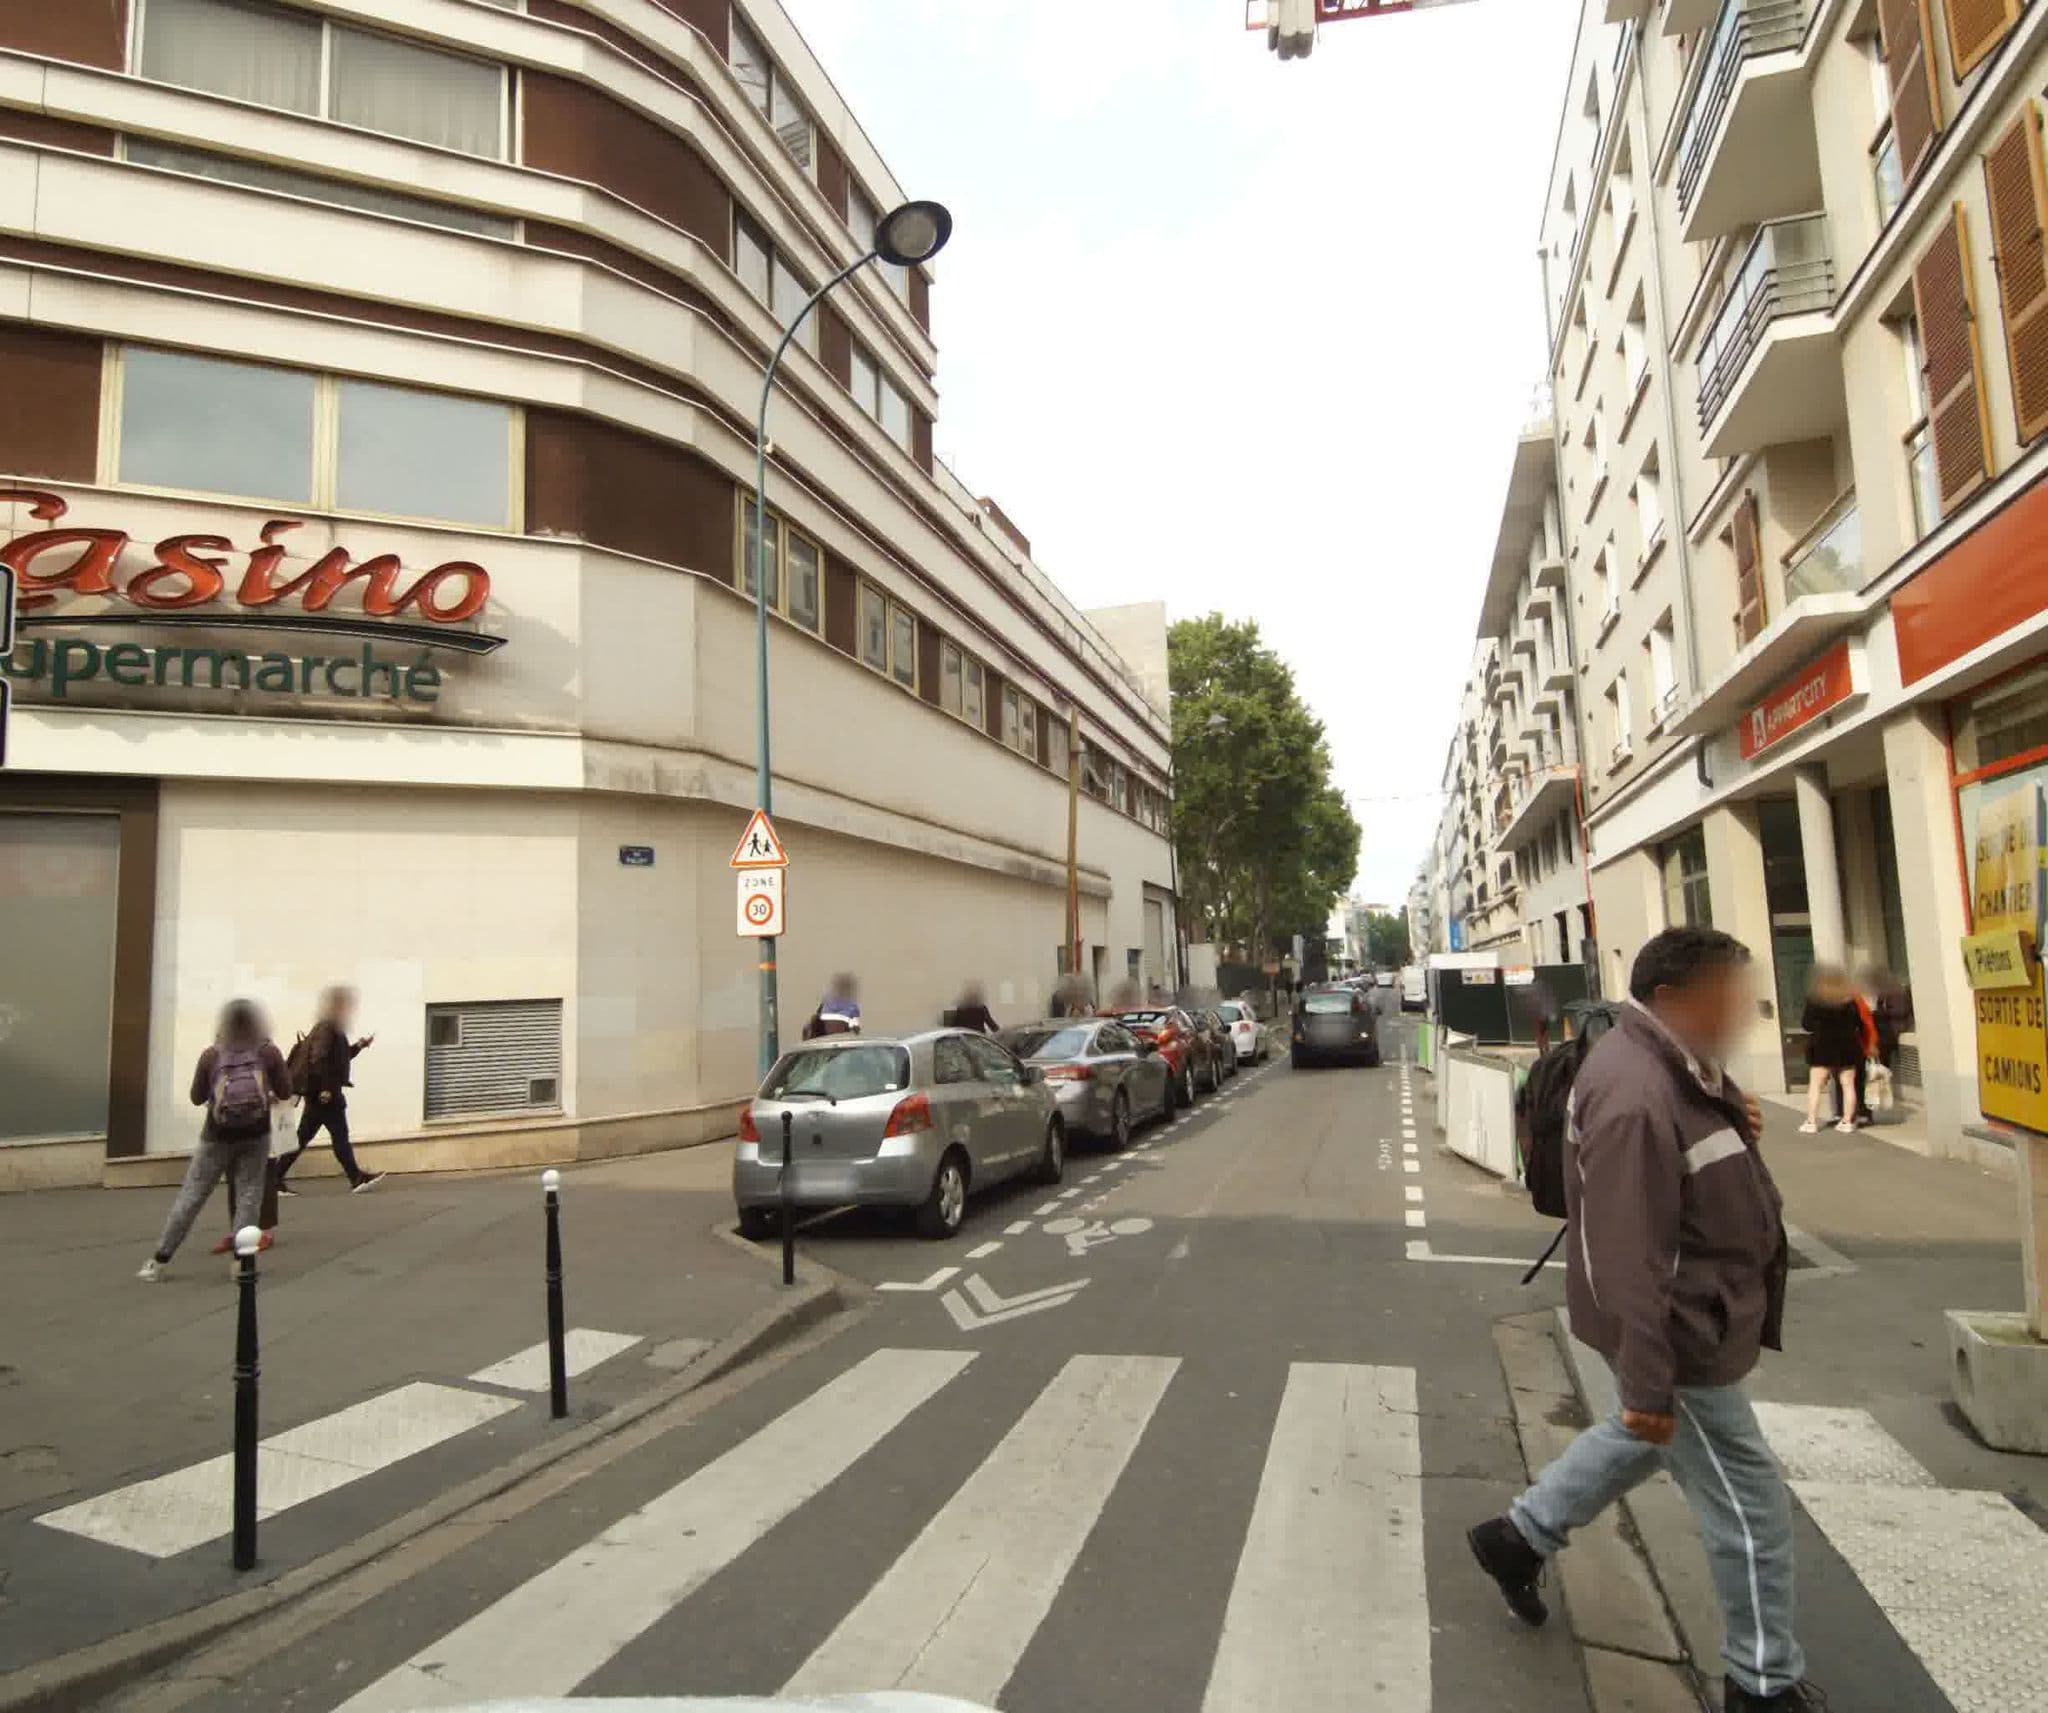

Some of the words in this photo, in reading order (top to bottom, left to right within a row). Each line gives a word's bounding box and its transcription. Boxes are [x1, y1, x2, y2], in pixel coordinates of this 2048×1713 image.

[0, 637, 442, 702] upermarché
[745, 876, 775, 889] ZONE
[752, 903, 767, 916] 30
[1979, 996, 2021, 1027] SORTIE
[2026, 997, 2043, 1029] DE
[1984, 1055, 2041, 1095] CAMIONS
